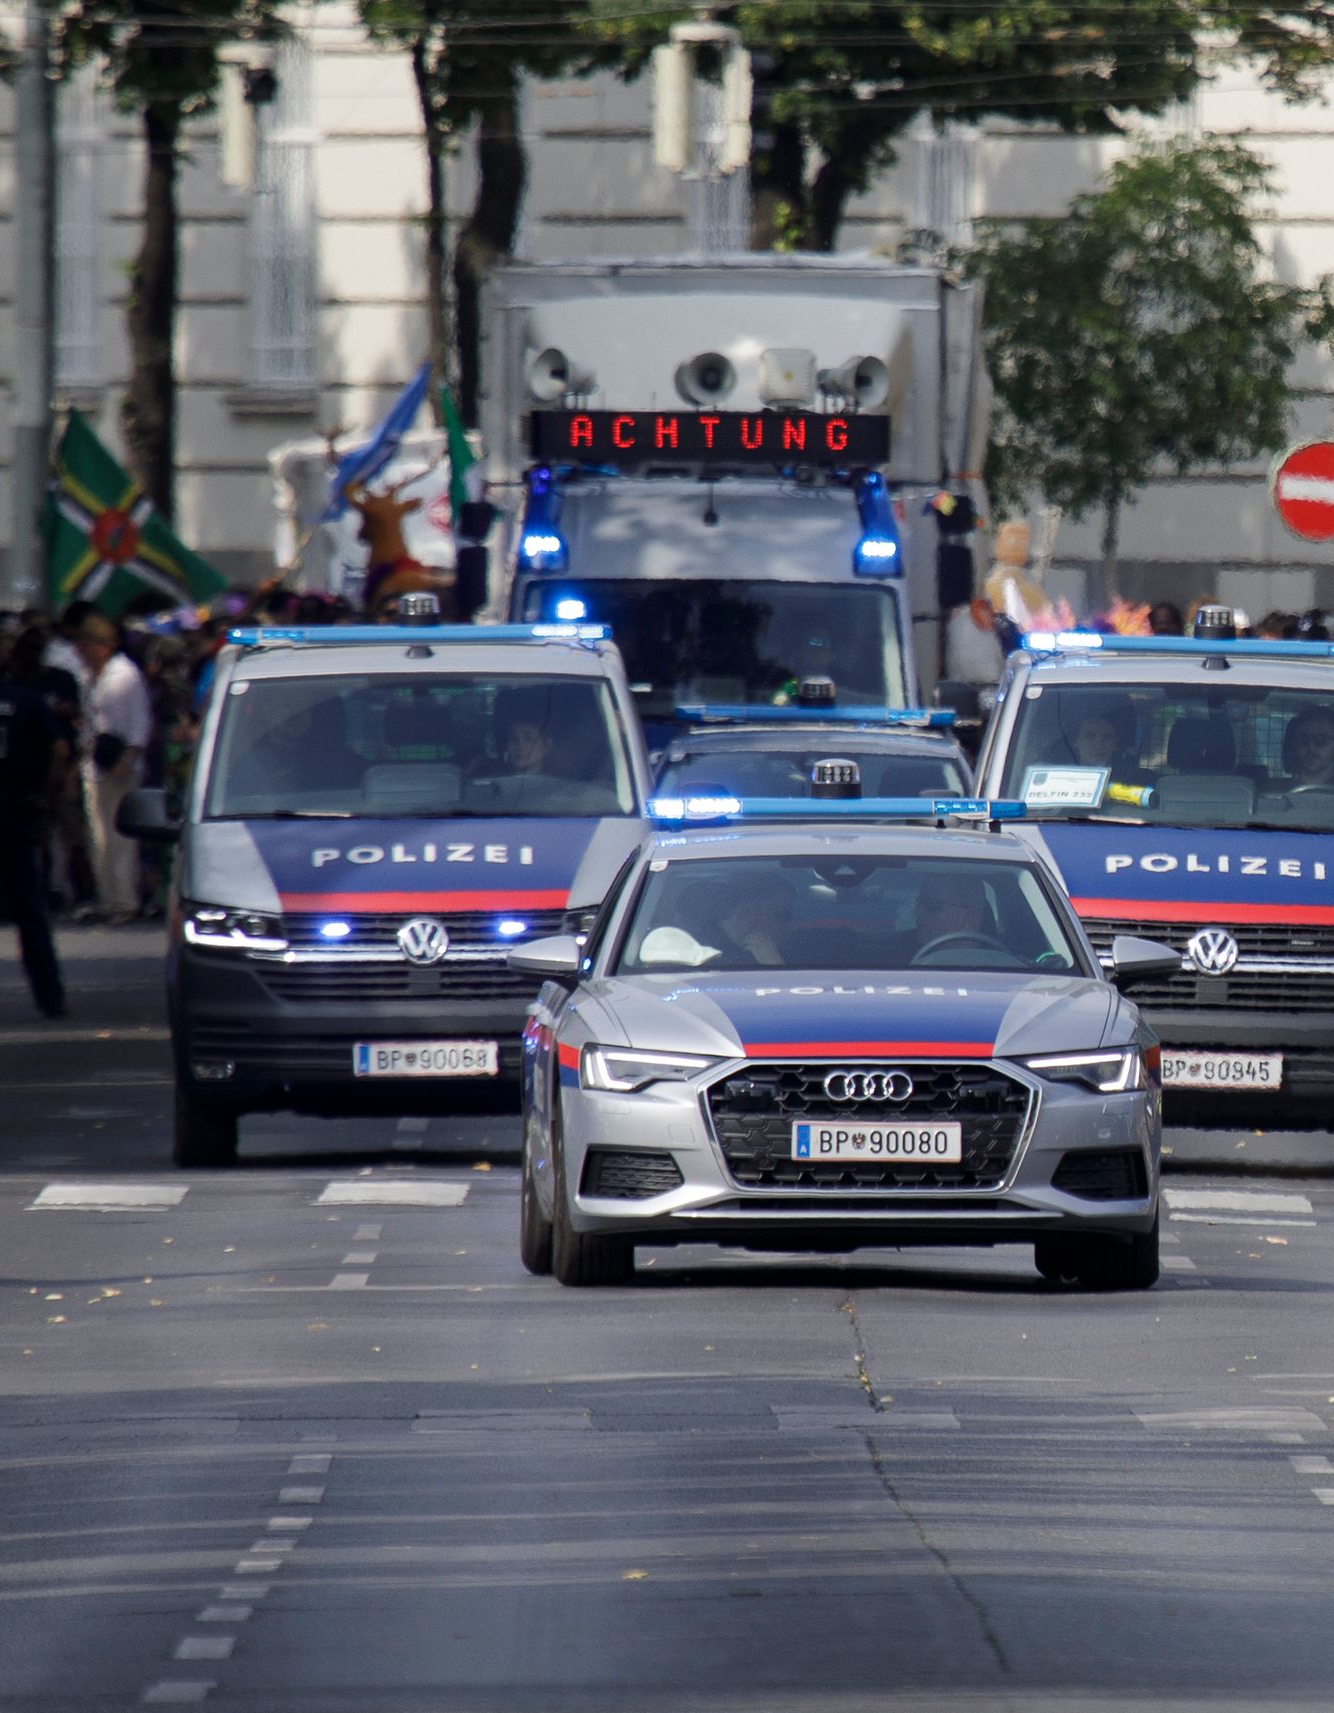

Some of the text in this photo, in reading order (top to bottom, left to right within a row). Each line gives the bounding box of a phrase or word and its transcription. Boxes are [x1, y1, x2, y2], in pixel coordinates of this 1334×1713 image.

[570, 416, 848, 450] ACHTUNG
[311, 843, 534, 868] POLIZEI
[1105, 854, 1326, 880] POLIZEI
[756, 986, 968, 997] POLIZEI
[820, 1131, 849, 1153] BP
[870, 1131, 948, 1154] 90080
